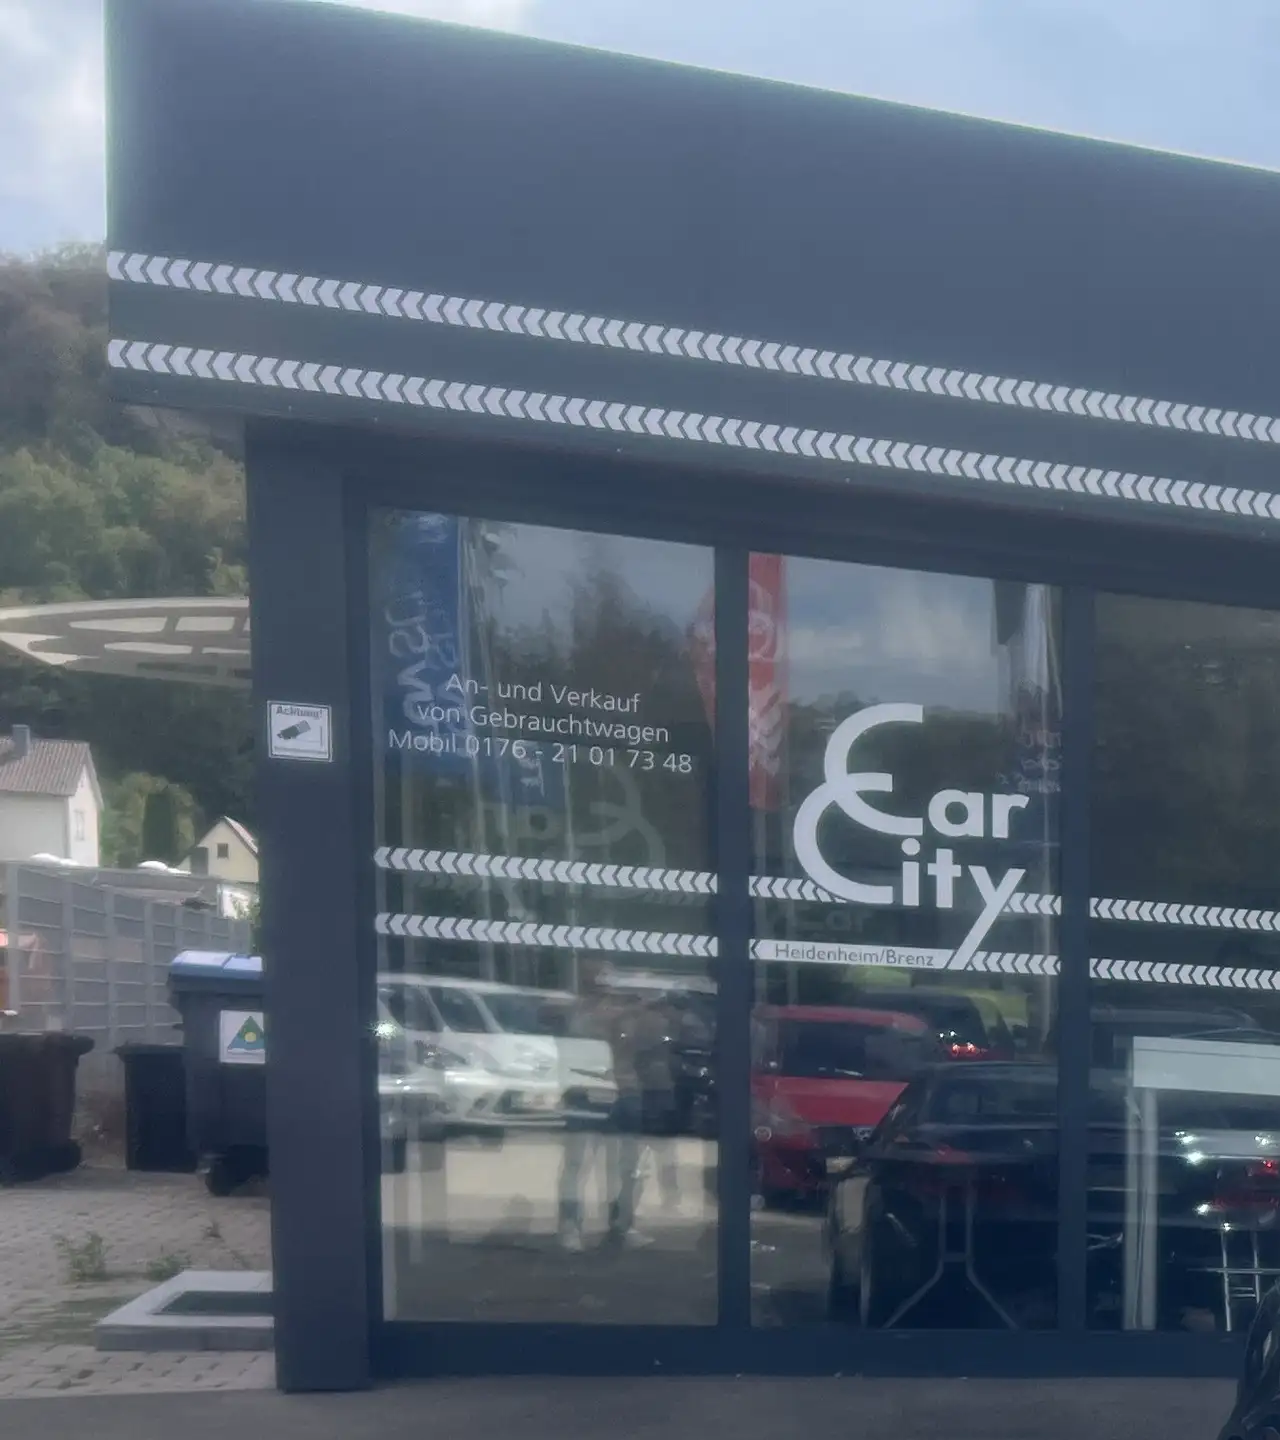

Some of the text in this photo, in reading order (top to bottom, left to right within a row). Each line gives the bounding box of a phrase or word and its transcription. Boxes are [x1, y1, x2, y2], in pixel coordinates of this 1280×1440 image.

[445, 673, 641, 713] An- und Verkauf
[417, 704, 669, 745] von Gebrauchtwagen
[388, 729, 456, 753] Mobil
[466, 736, 527, 760] 0176
[552, 742, 578, 764] 21
[589, 746, 616, 767] 01
[628, 750, 655, 771] 73
[663, 753, 693, 774] 48
[774, 943, 934, 966] Heidenheim/Brenz
